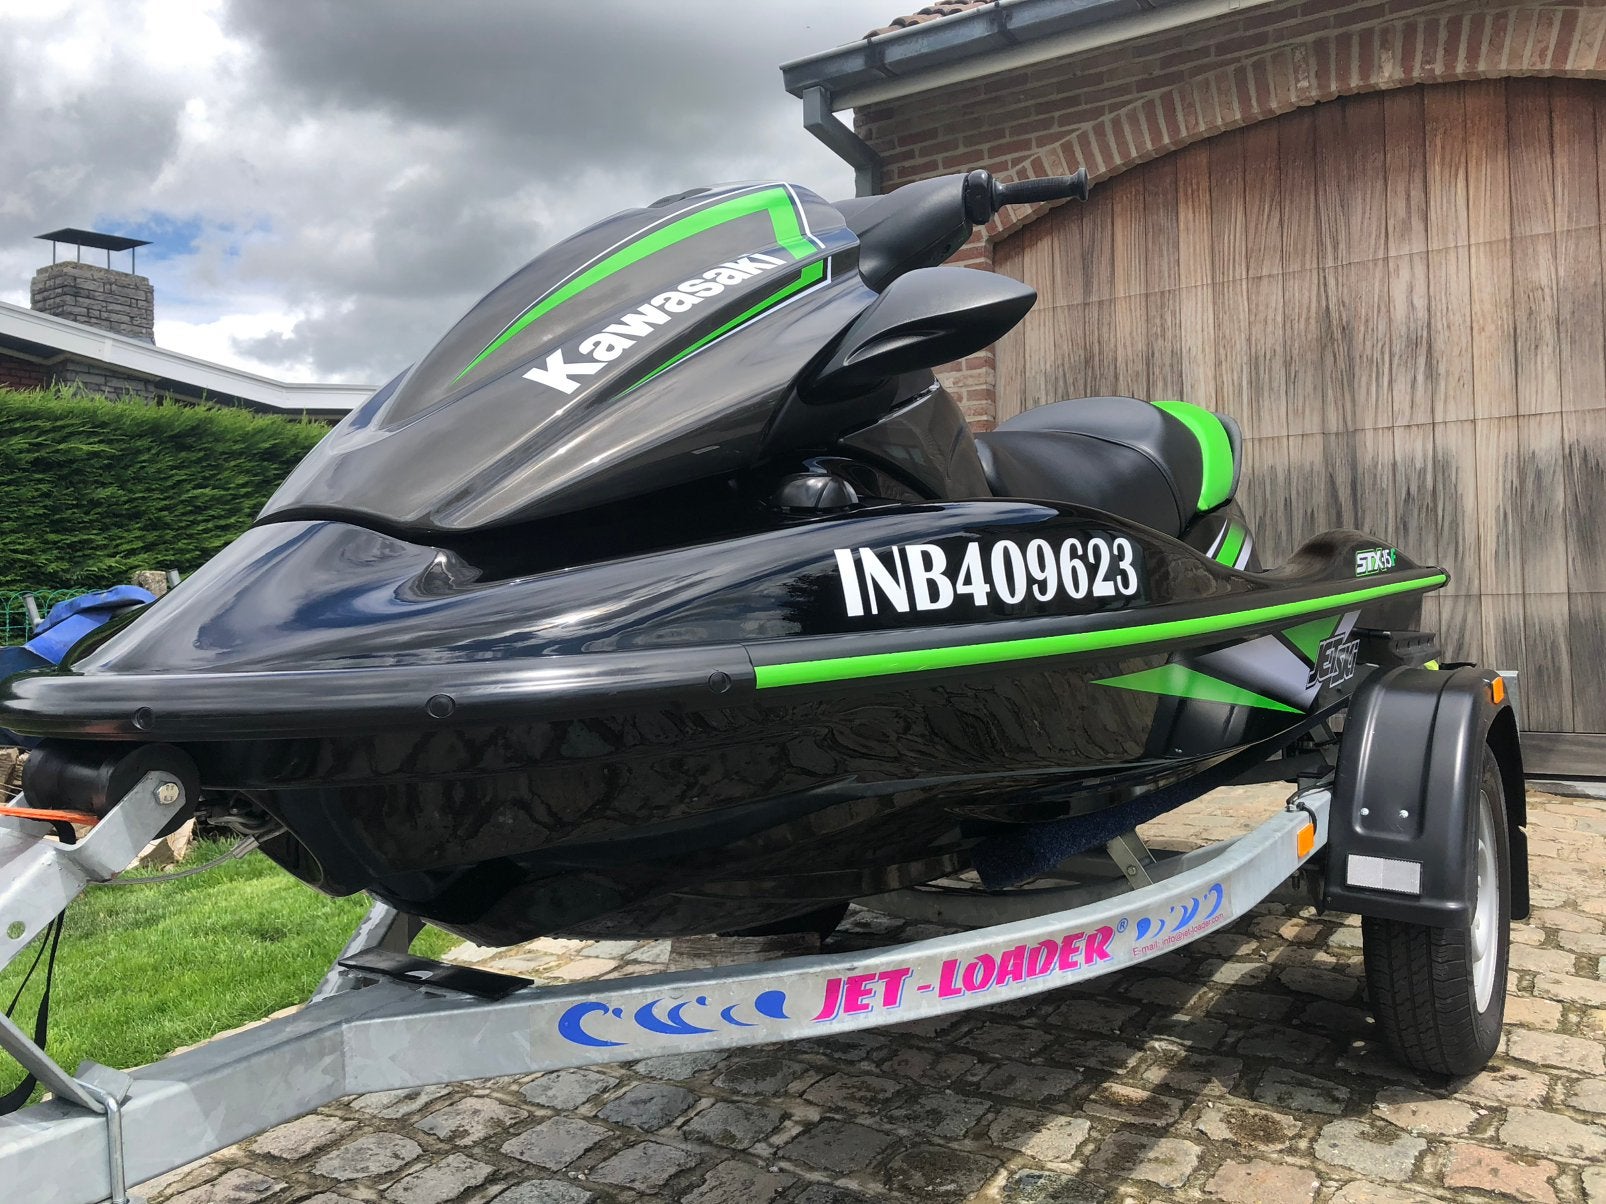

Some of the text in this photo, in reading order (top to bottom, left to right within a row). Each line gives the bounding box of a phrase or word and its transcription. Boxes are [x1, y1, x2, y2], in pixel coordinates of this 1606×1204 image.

[522, 253, 788, 395] Kawasaki
[834, 538, 1138, 617] INB409623
[1162, 913, 1224, 946] info@jet-loader.com
